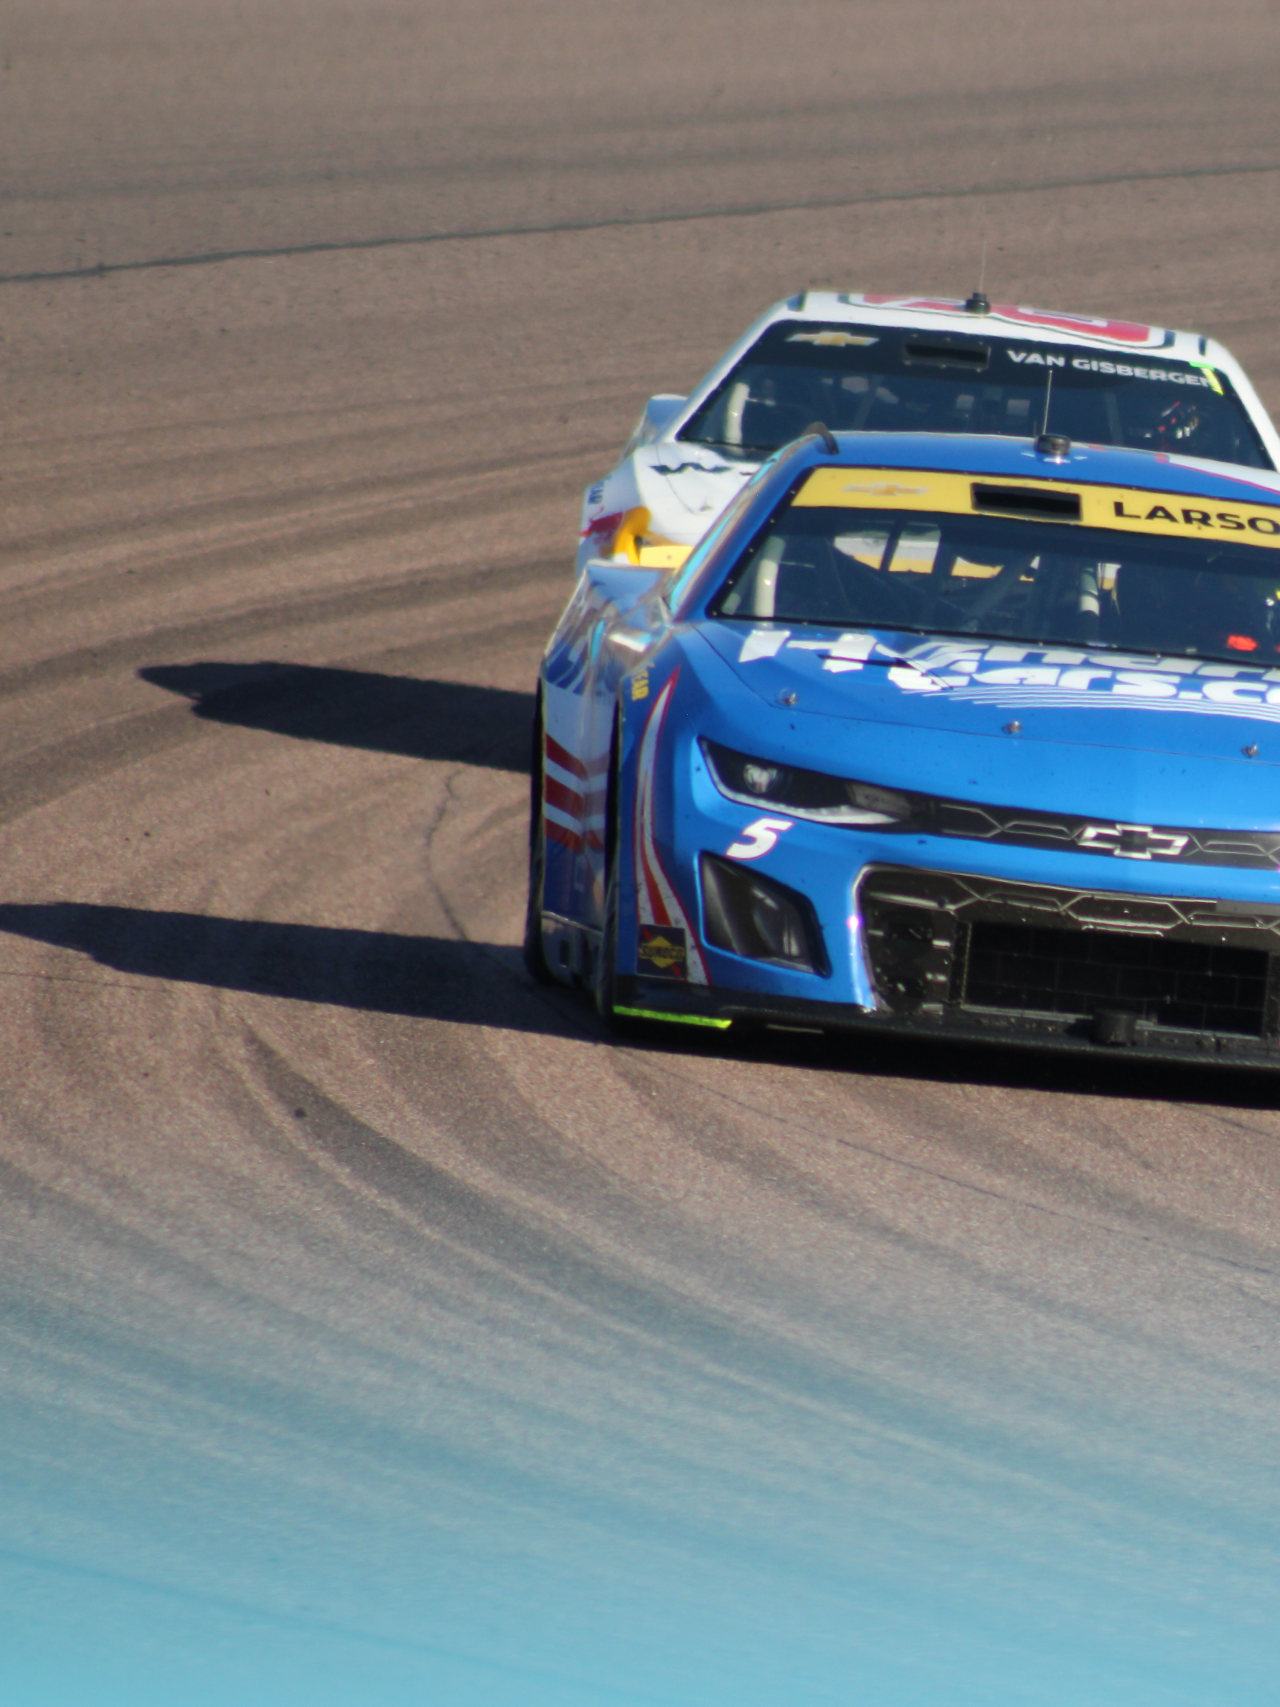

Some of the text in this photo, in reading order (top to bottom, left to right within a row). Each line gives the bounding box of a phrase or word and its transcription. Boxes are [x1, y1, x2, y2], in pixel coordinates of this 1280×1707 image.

[1007, 350, 1066, 368] VAN
[724, 817, 794, 860] 5
[638, 943, 687, 962] SUNOCO
